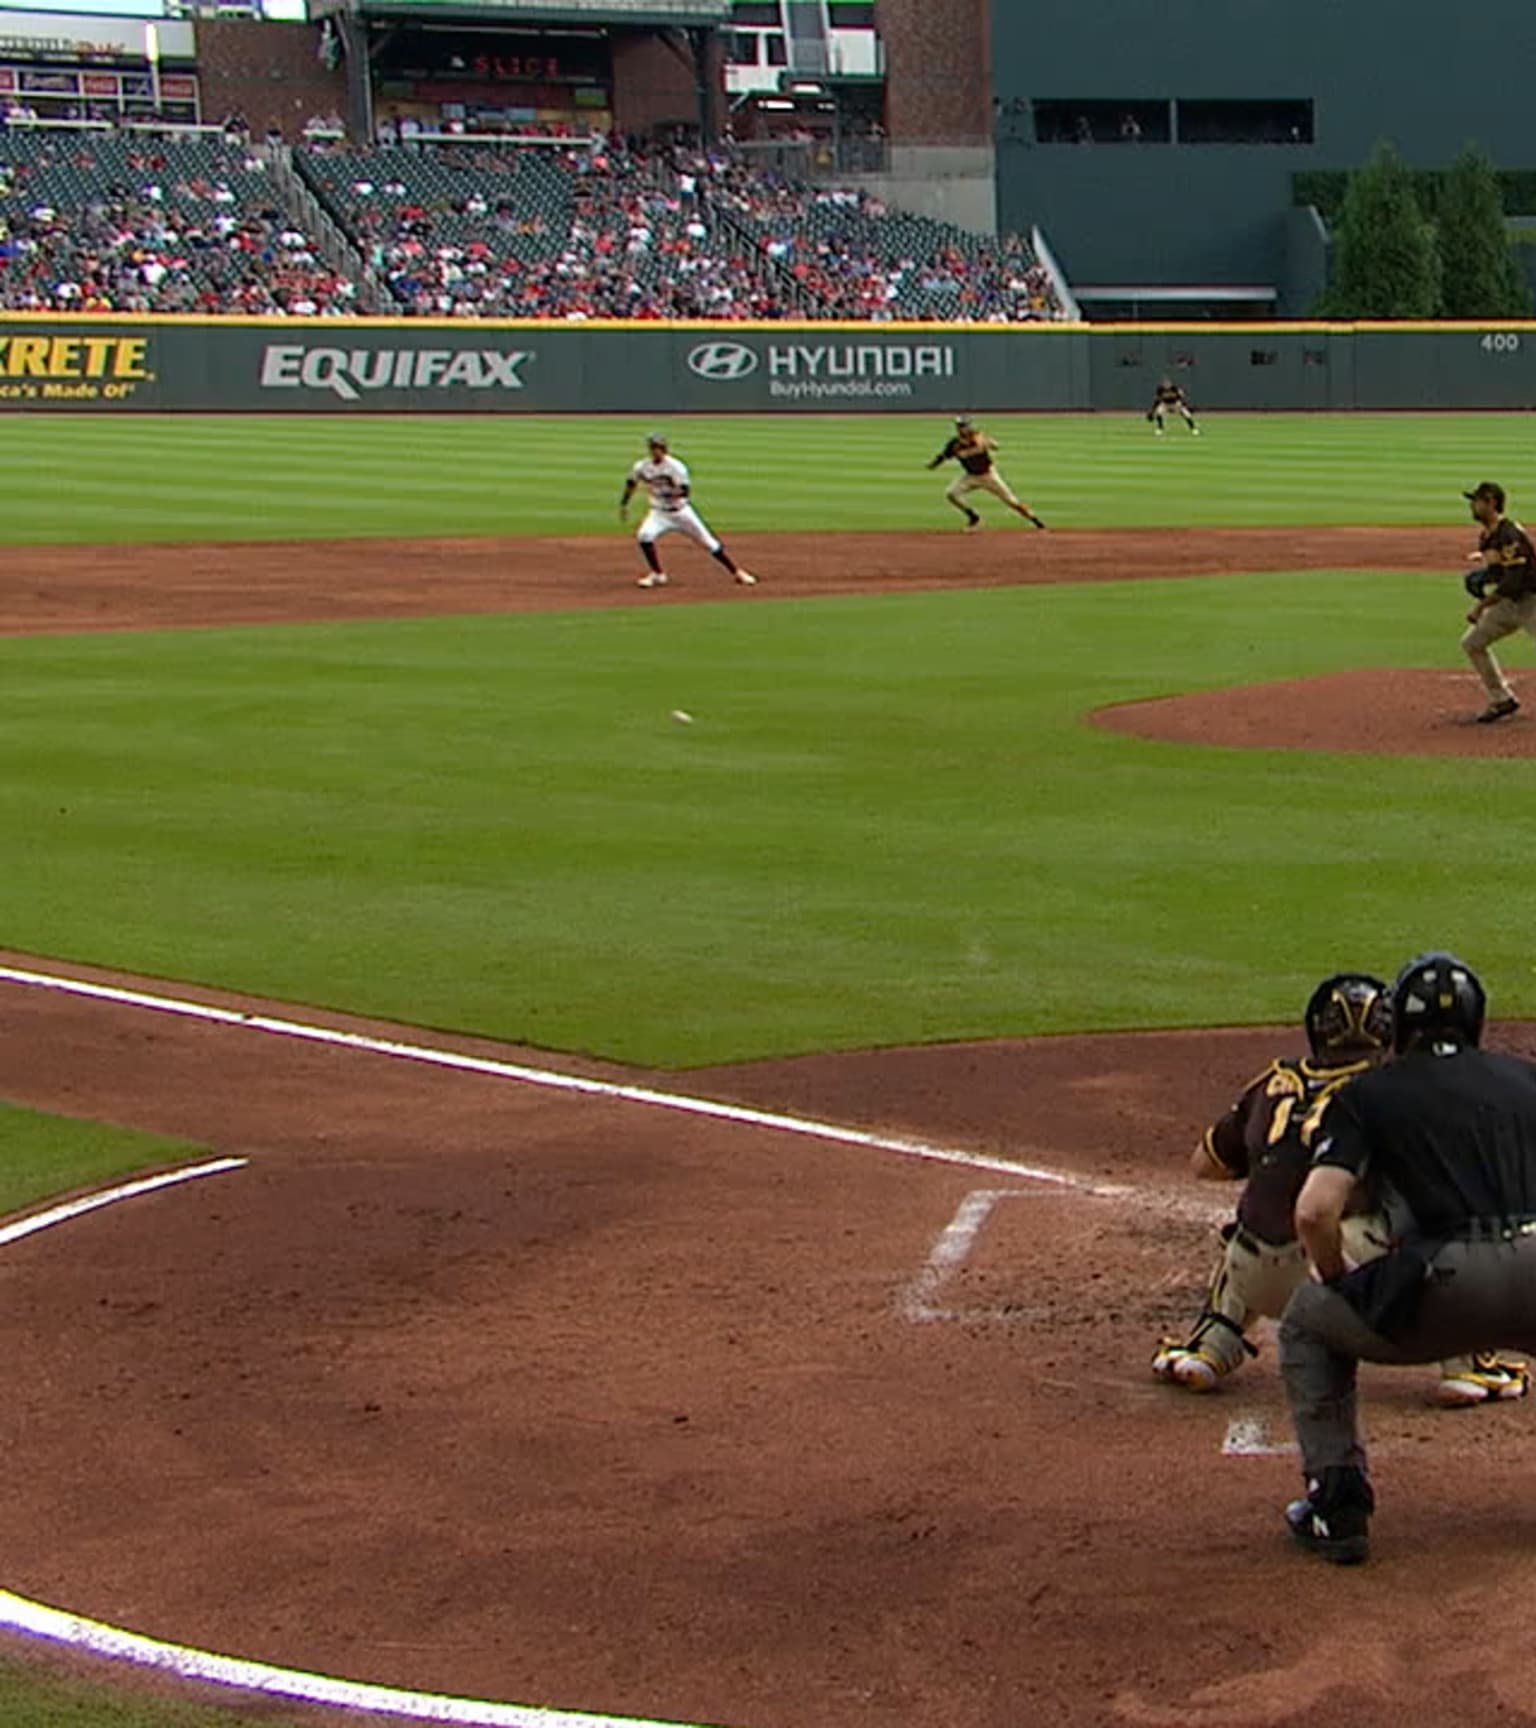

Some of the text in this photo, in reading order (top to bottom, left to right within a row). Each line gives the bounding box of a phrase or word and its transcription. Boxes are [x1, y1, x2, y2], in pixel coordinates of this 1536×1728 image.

[1481, 333, 1519, 351] 400
[0, 337, 147, 377] RETE
[769, 346, 954, 376] HYUNDAI
[260, 345, 530, 400] EQUIFAX
[43, 383, 98, 398] Made
[770, 380, 912, 399] BuyHyundai.com
